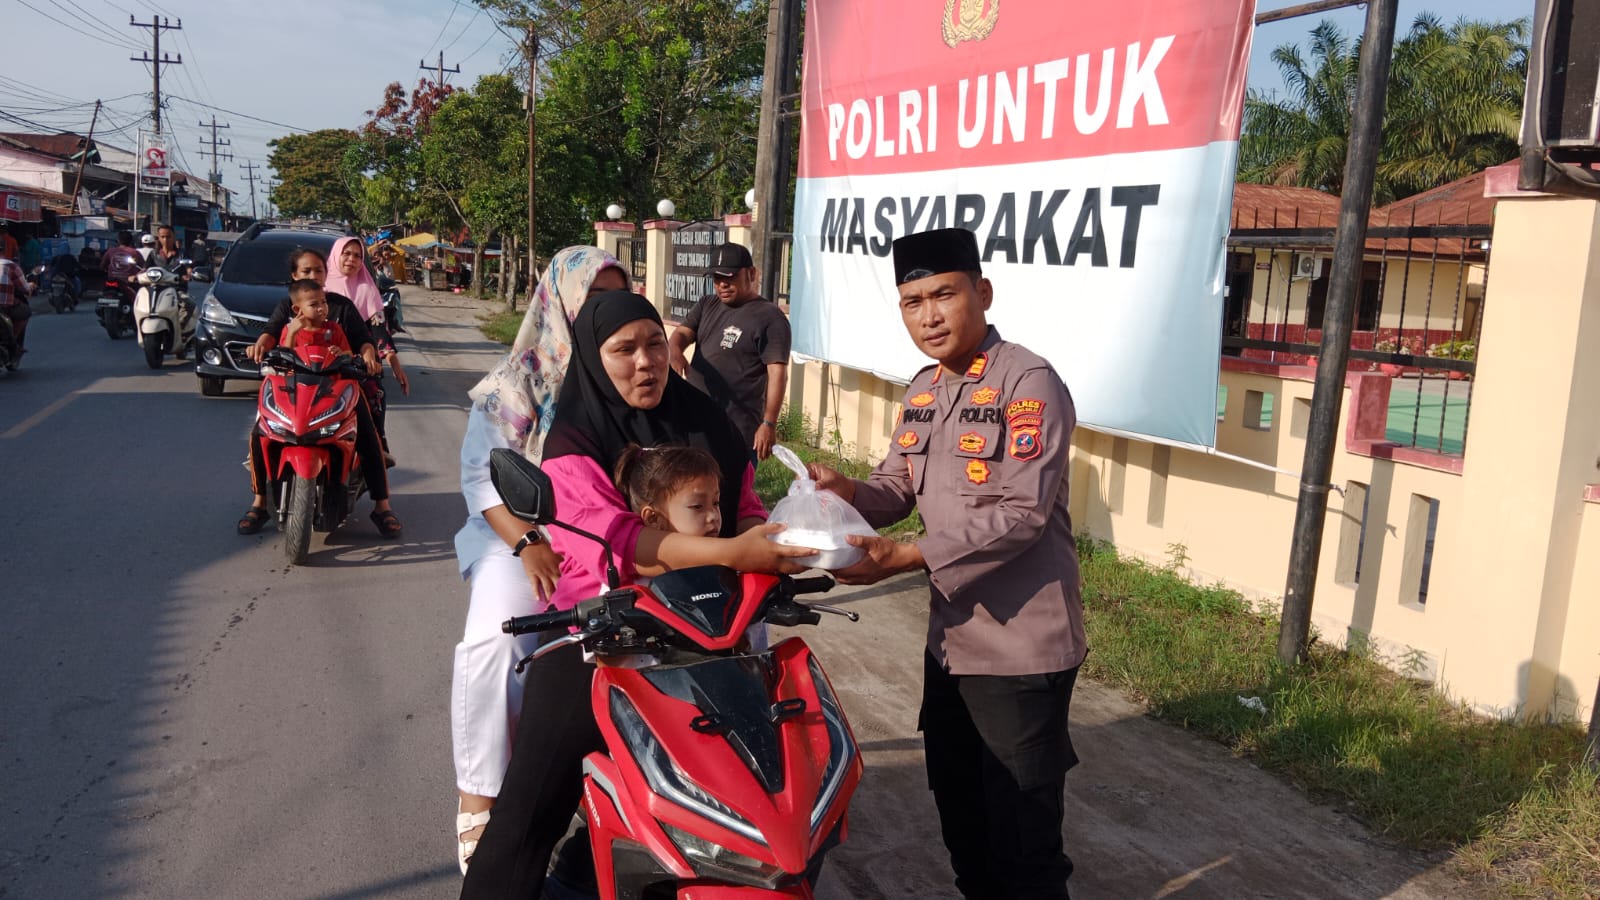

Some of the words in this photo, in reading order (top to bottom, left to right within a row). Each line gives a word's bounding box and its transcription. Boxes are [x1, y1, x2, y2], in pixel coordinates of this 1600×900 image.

[828, 85, 938, 161] POLRI
[957, 35, 1175, 149] UNTUK
[959, 407, 1001, 424] POLRI
[691, 592, 722, 601] HOND
[584, 781, 601, 828] HONDA
